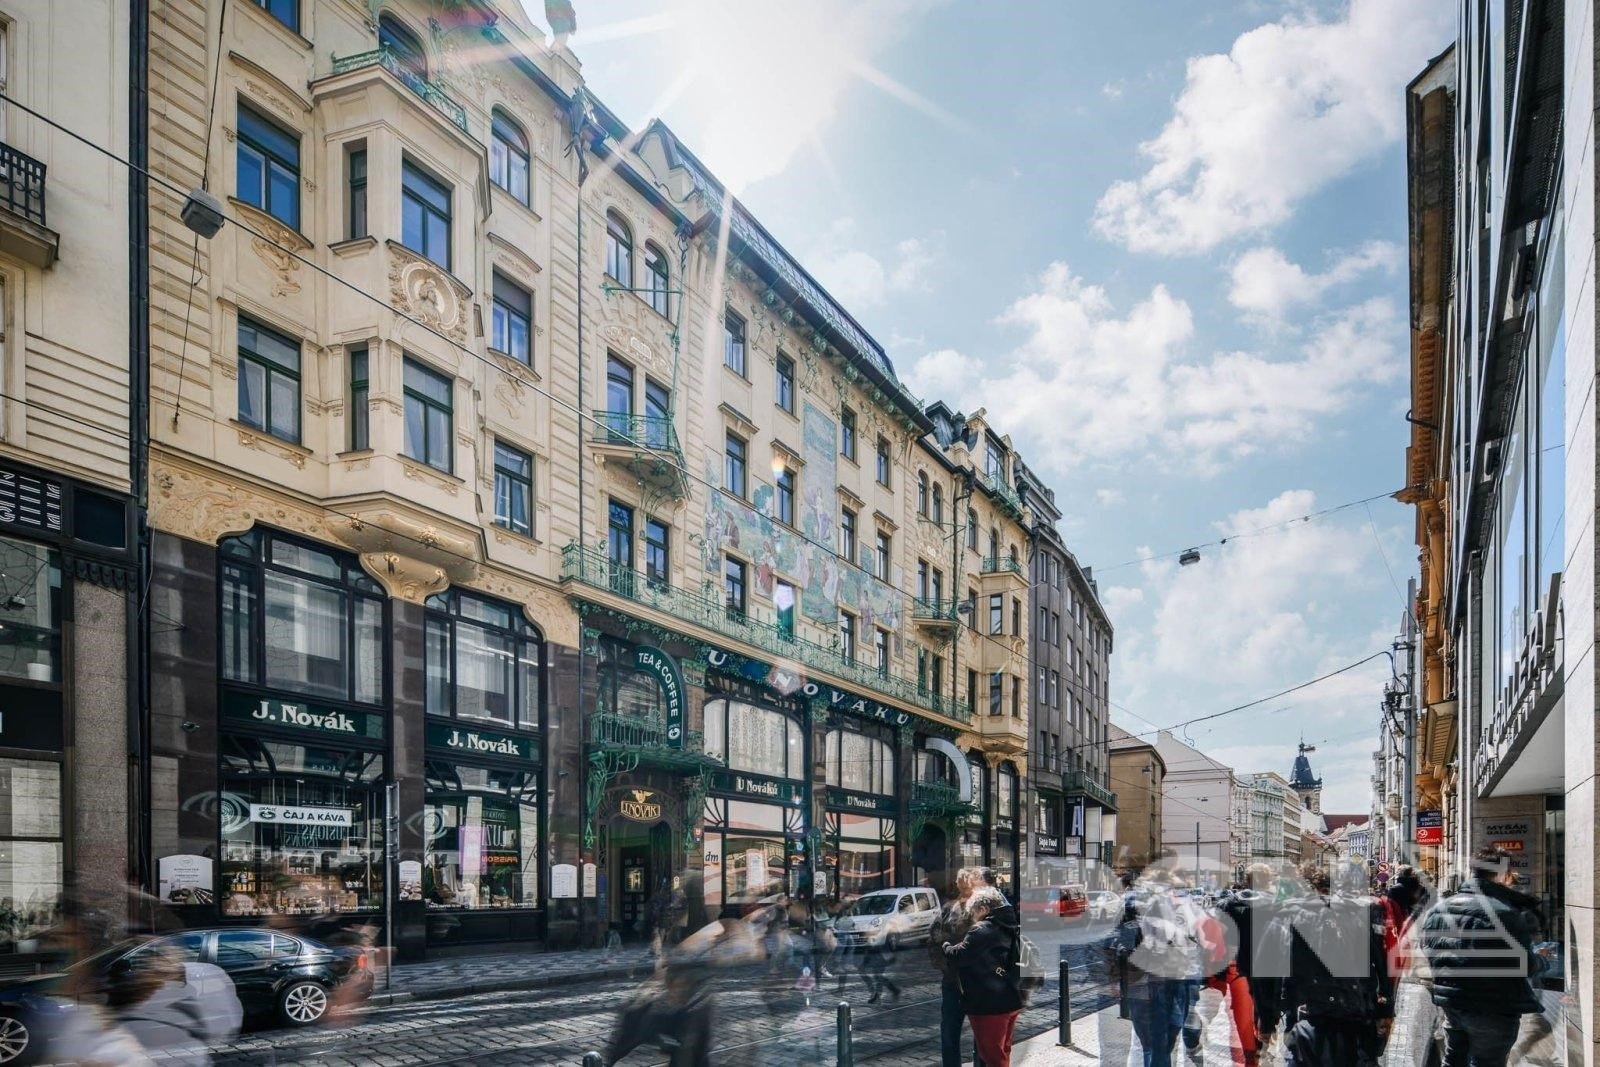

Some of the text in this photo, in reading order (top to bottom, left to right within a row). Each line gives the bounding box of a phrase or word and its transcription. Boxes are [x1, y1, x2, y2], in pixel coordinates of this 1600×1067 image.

[708, 650, 727, 666] U
[638, 652, 654, 665] TEA
[655, 659, 662, 671] &
[661, 666, 679, 717] COFFEE
[252, 701, 356, 732] J. Novák
[447, 731, 520, 755] J. Novák
[736, 777, 745, 792] U
[283, 809, 345, 822] ČAJ A KÁVA
[705, 851, 719, 862] dm
